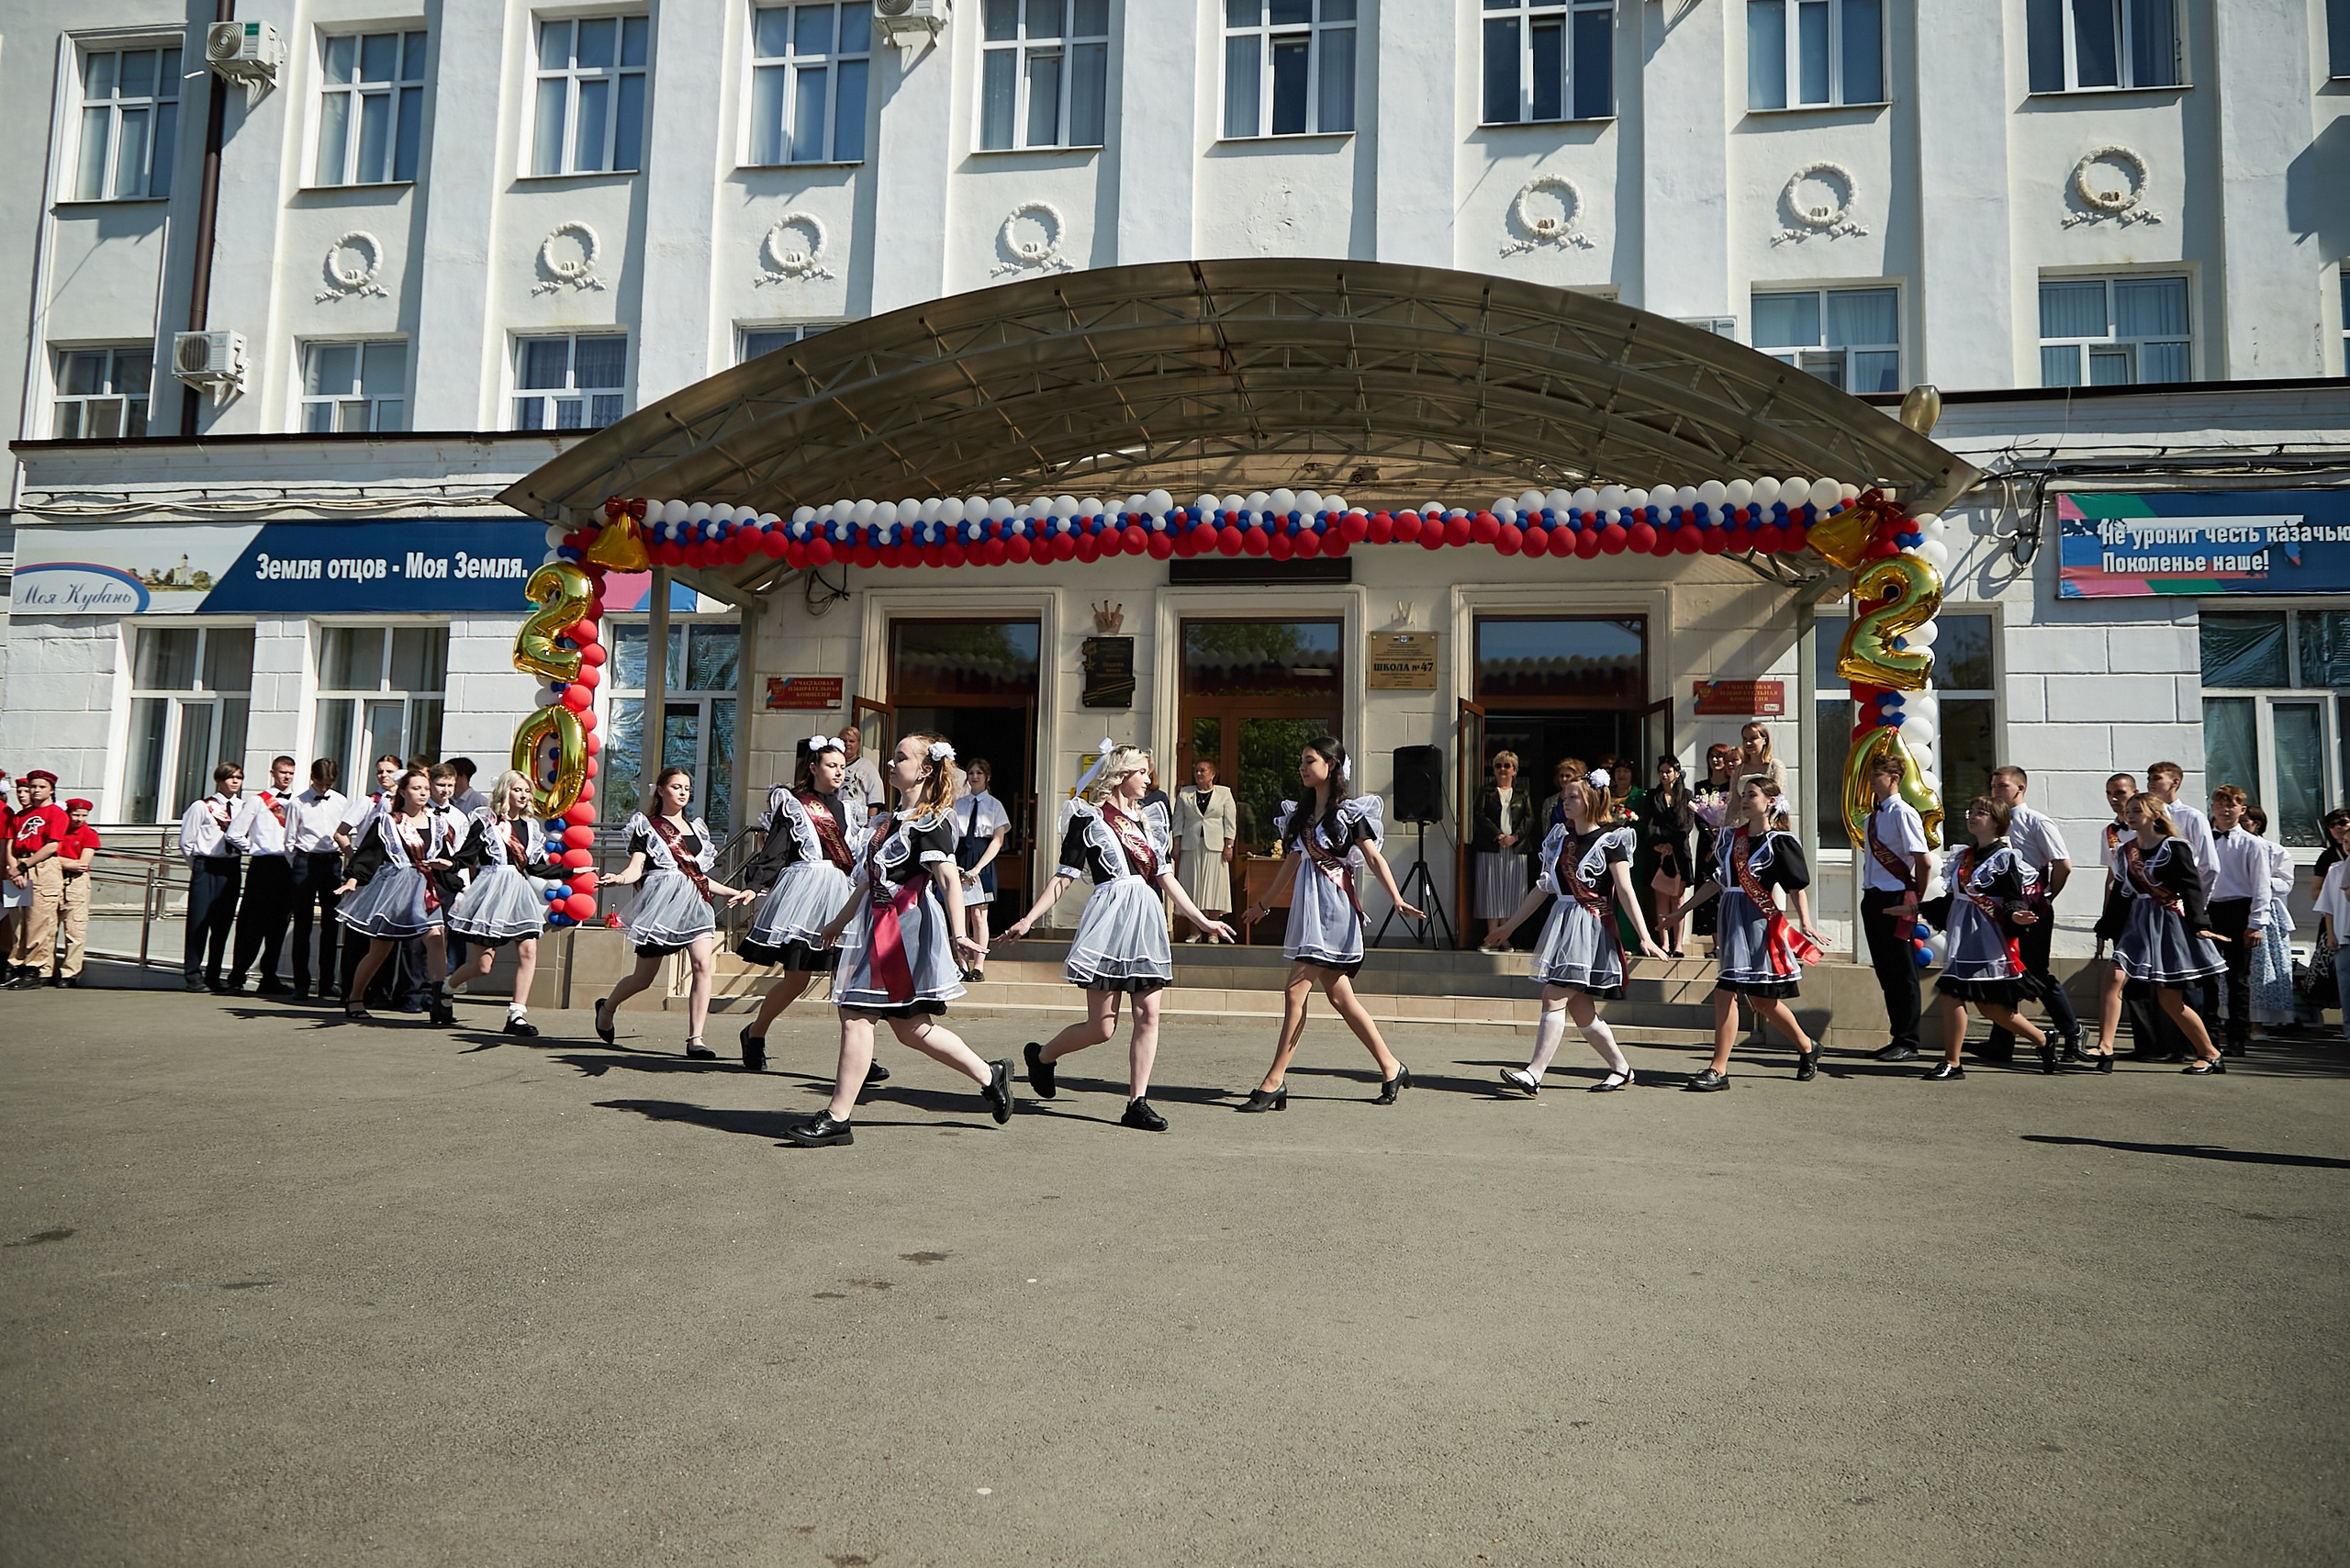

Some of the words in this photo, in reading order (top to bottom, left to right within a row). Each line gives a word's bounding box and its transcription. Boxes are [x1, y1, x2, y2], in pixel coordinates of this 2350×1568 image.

[2101, 523, 2126, 545] Не
[2132, 527, 2199, 550] уронит
[2204, 526, 2260, 543] честь
[2266, 525, 2350, 543] казачью
[255, 553, 322, 580] Земля
[327, 558, 387, 584] отцов
[405, 552, 448, 578] Моя
[453, 551, 529, 578] Земля.
[2102, 552, 2207, 573] Поколенье
[2212, 549, 2270, 571] наше!
[15, 584, 56, 606] Моя
[61, 582, 132, 612] Кубань
[1373, 663, 1410, 671] ШКОЛА
[1421, 661, 1434, 671] 47
